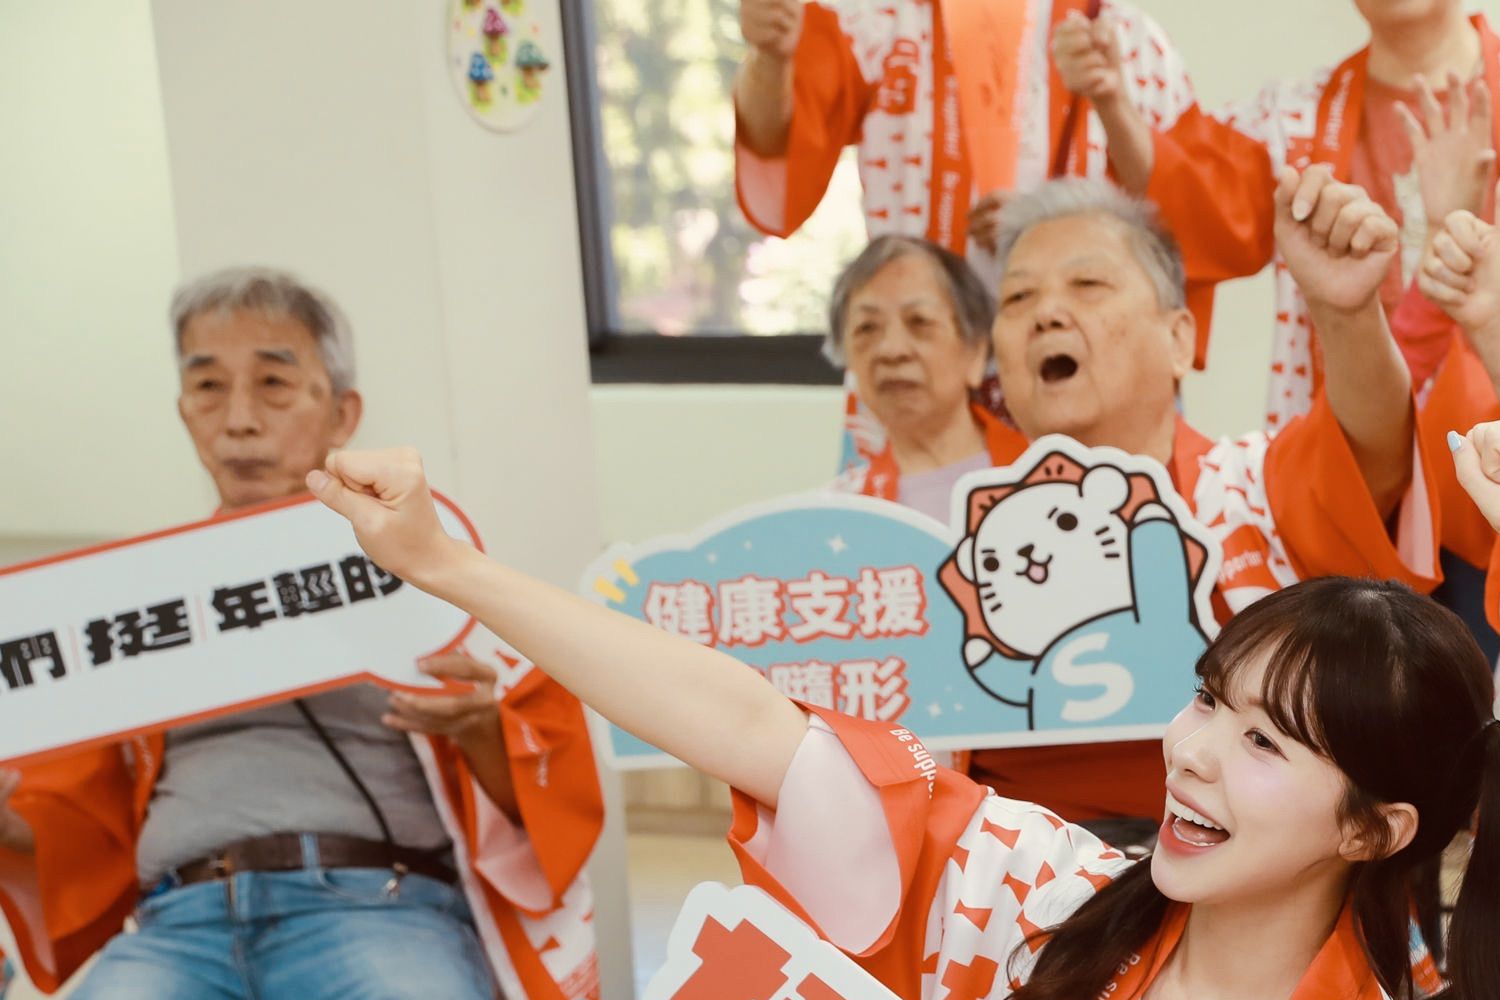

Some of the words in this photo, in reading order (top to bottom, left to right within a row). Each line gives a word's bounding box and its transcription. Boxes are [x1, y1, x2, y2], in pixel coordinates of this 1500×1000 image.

[645, 565, 929, 648] 健康支援
[889, 728, 913, 742] Be
